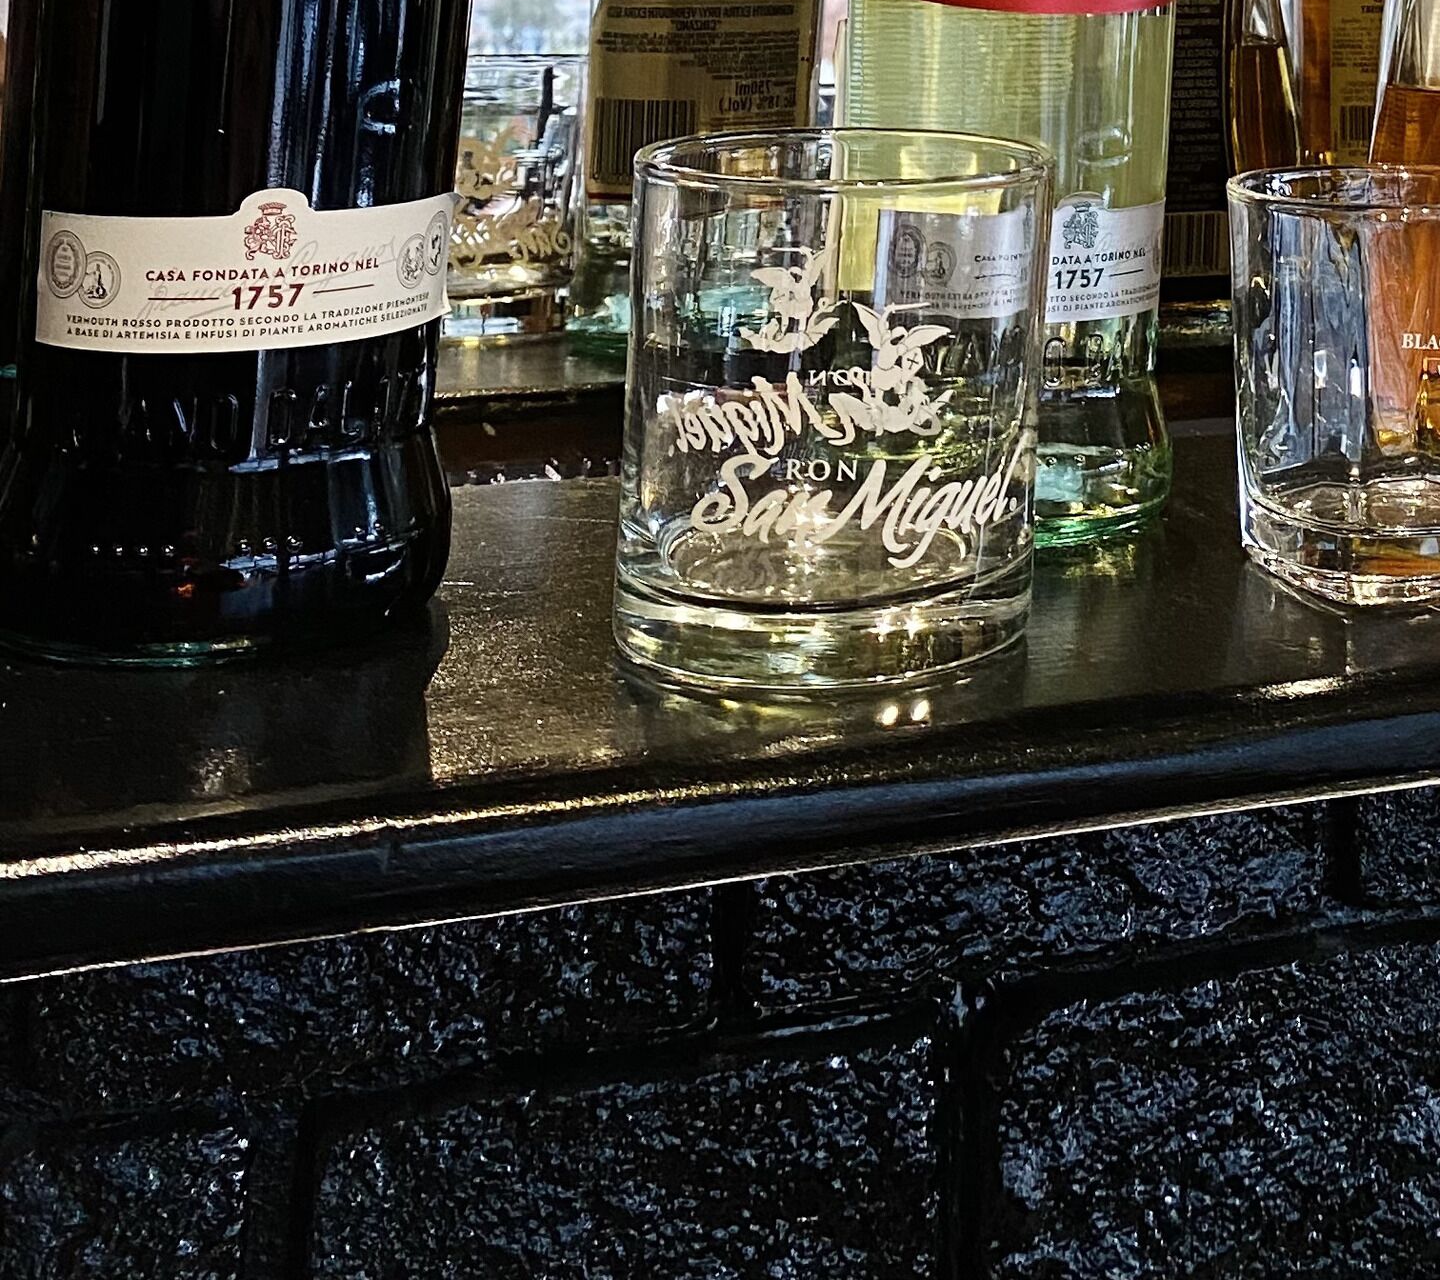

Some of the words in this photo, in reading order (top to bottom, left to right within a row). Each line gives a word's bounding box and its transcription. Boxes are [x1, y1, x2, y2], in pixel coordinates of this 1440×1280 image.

[1095, 250, 1131, 262] TORINO
[146, 270, 186, 282] CASA
[192, 268, 269, 281] FONDATA
[275, 269, 285, 279] A
[291, 261, 350, 277] TORINO
[355, 257, 379, 271] NEL
[1055, 268, 1104, 289] 1757
[232, 283, 304, 310] 1757
[1070, 291, 1108, 302] SECONDO
[67, 314, 118, 327] VERMOUTH
[122, 318, 161, 328] ROSSO
[166, 318, 234, 328] PRODOTTO
[240, 314, 299, 326] SECONDO
[304, 312, 317, 320] LA
[322, 303, 383, 319] TRADIZIONE
[67, 327, 73, 335] A
[75, 328, 99, 337] BASE
[103, 329, 113, 337] DI
[116, 330, 180, 339] ARTEMISIA
[196, 330, 237, 338] INFUSI
[242, 328, 255, 337] DI
[260, 325, 303, 336] PIANTE
[308, 316, 378, 332] AROMATICHE
[786, 459, 858, 482] RON
